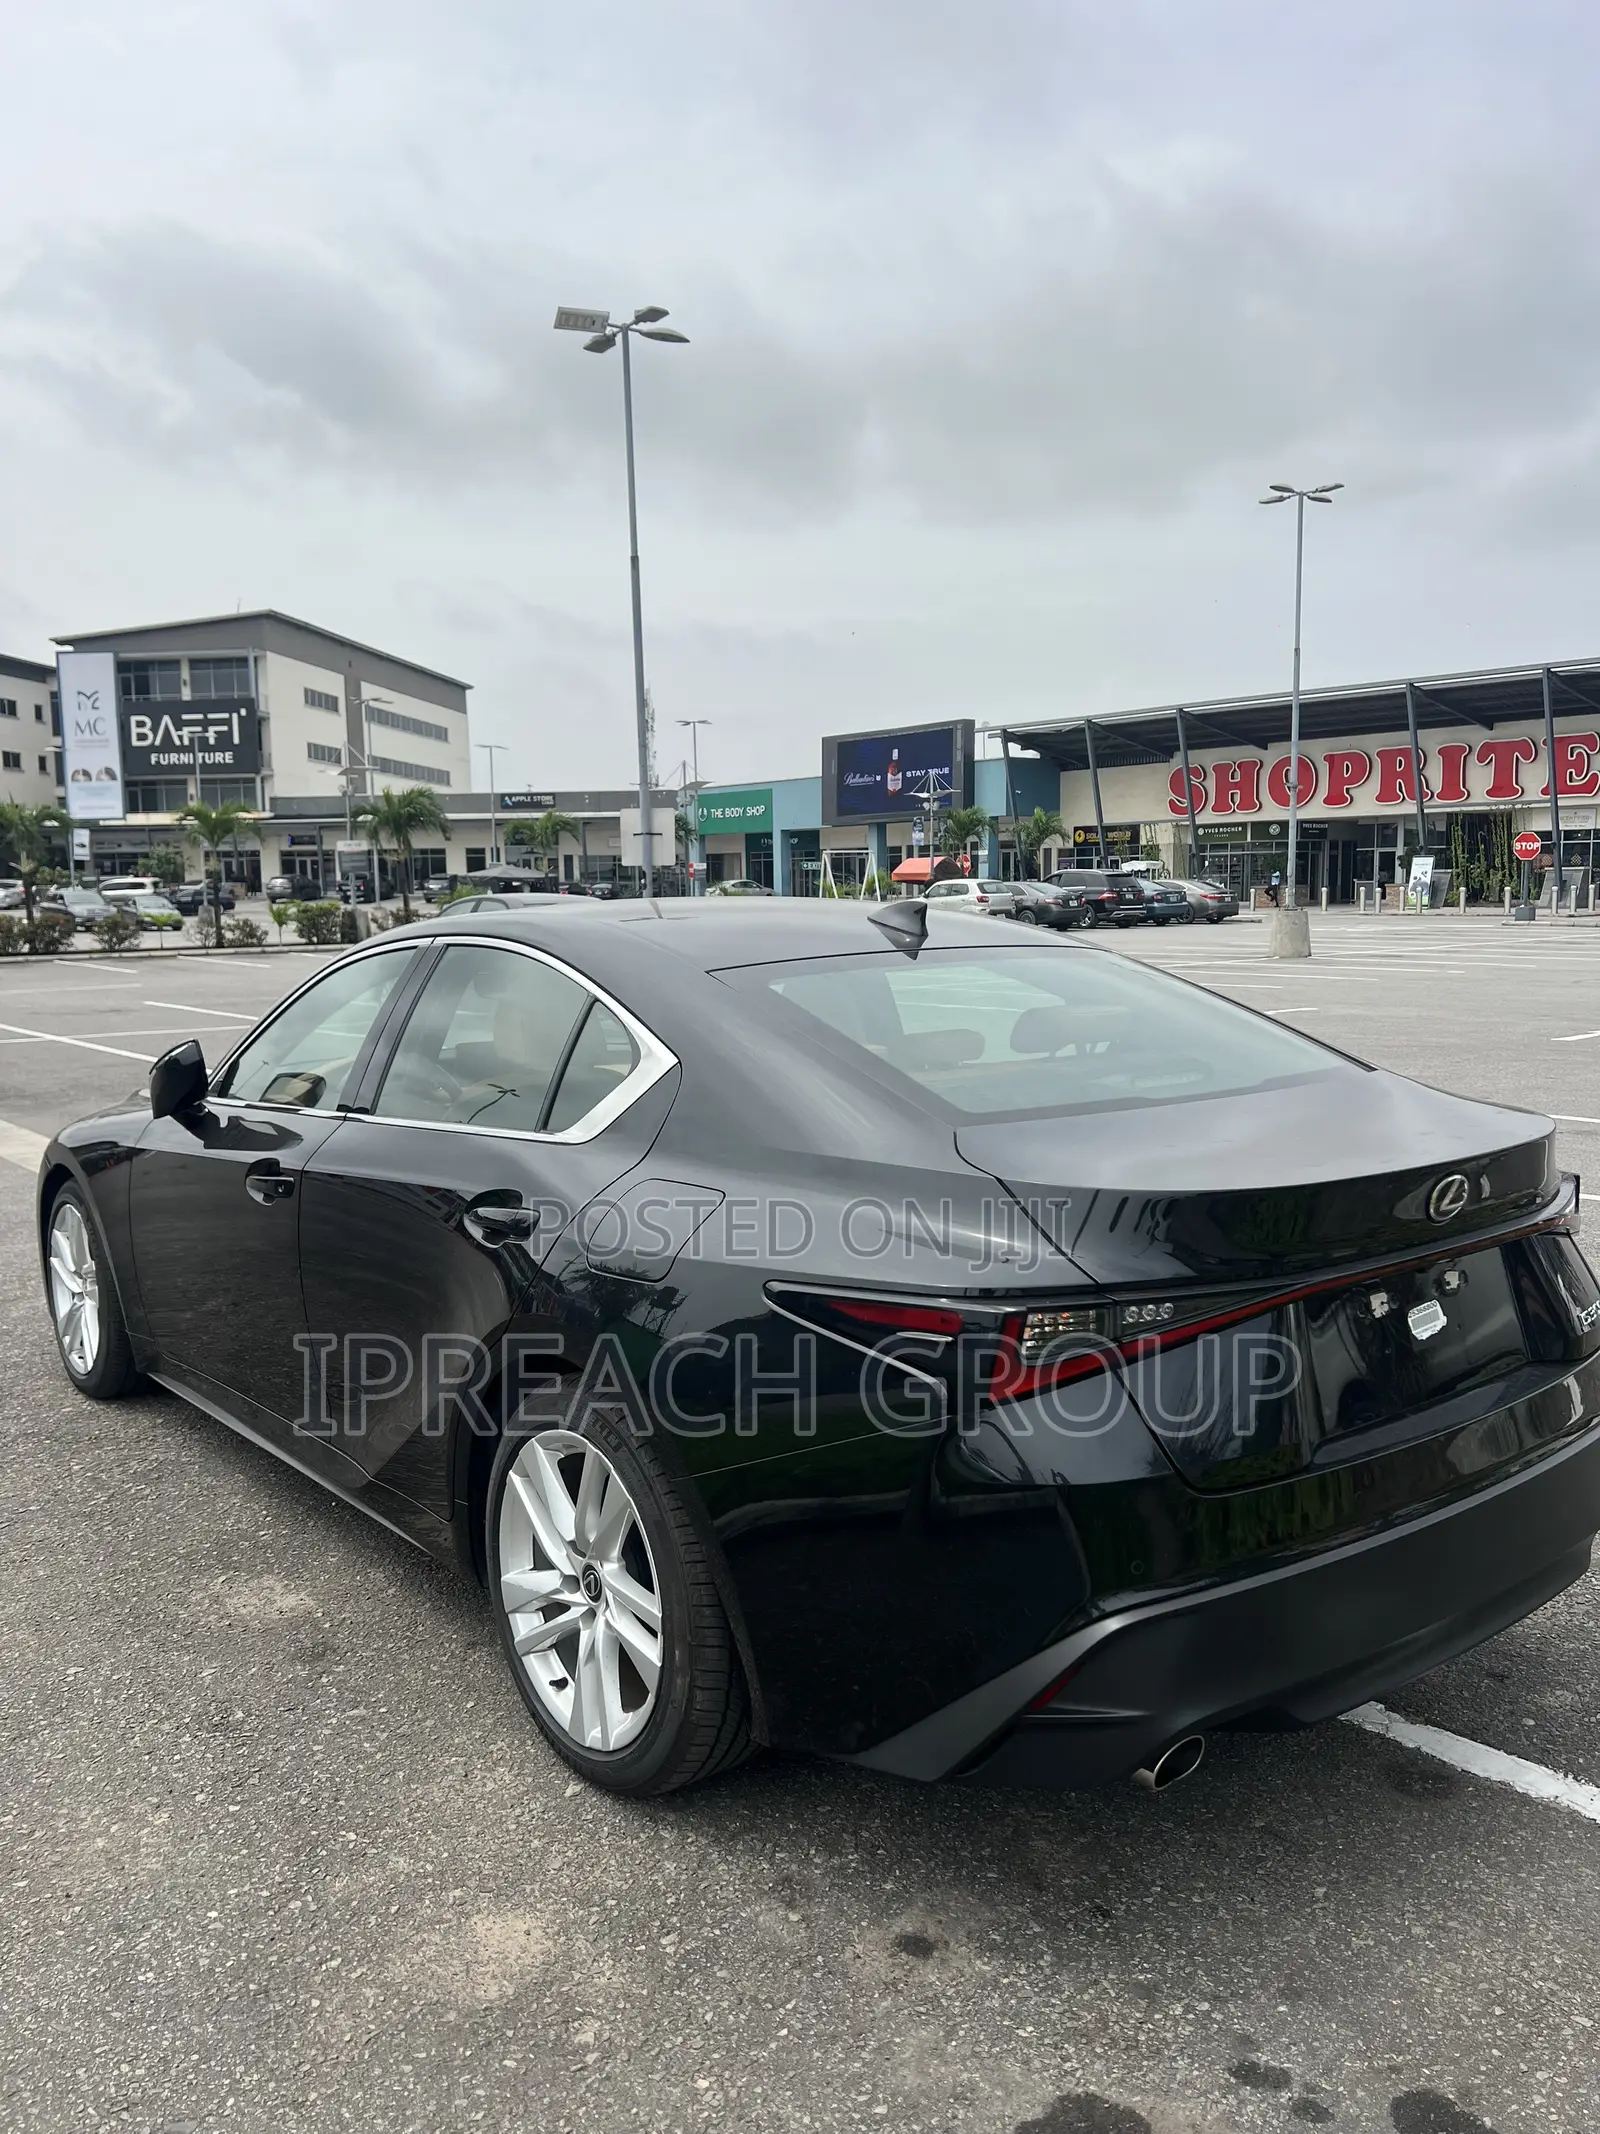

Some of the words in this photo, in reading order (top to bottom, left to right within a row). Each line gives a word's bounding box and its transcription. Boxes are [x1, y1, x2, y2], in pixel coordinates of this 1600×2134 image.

[74, 717, 106, 737] MC
[130, 711, 242, 747] BAFFI
[150, 752, 234, 765] FURNITURE
[906, 769, 926, 777] STAY
[928, 767, 949, 775] TRUE
[1168, 731, 1600, 816] SHOPRITE
[711, 808, 724, 818] THE
[725, 807, 744, 817] BODY
[746, 805, 765, 816] SHOP
[1515, 842, 1540, 850] STOP
